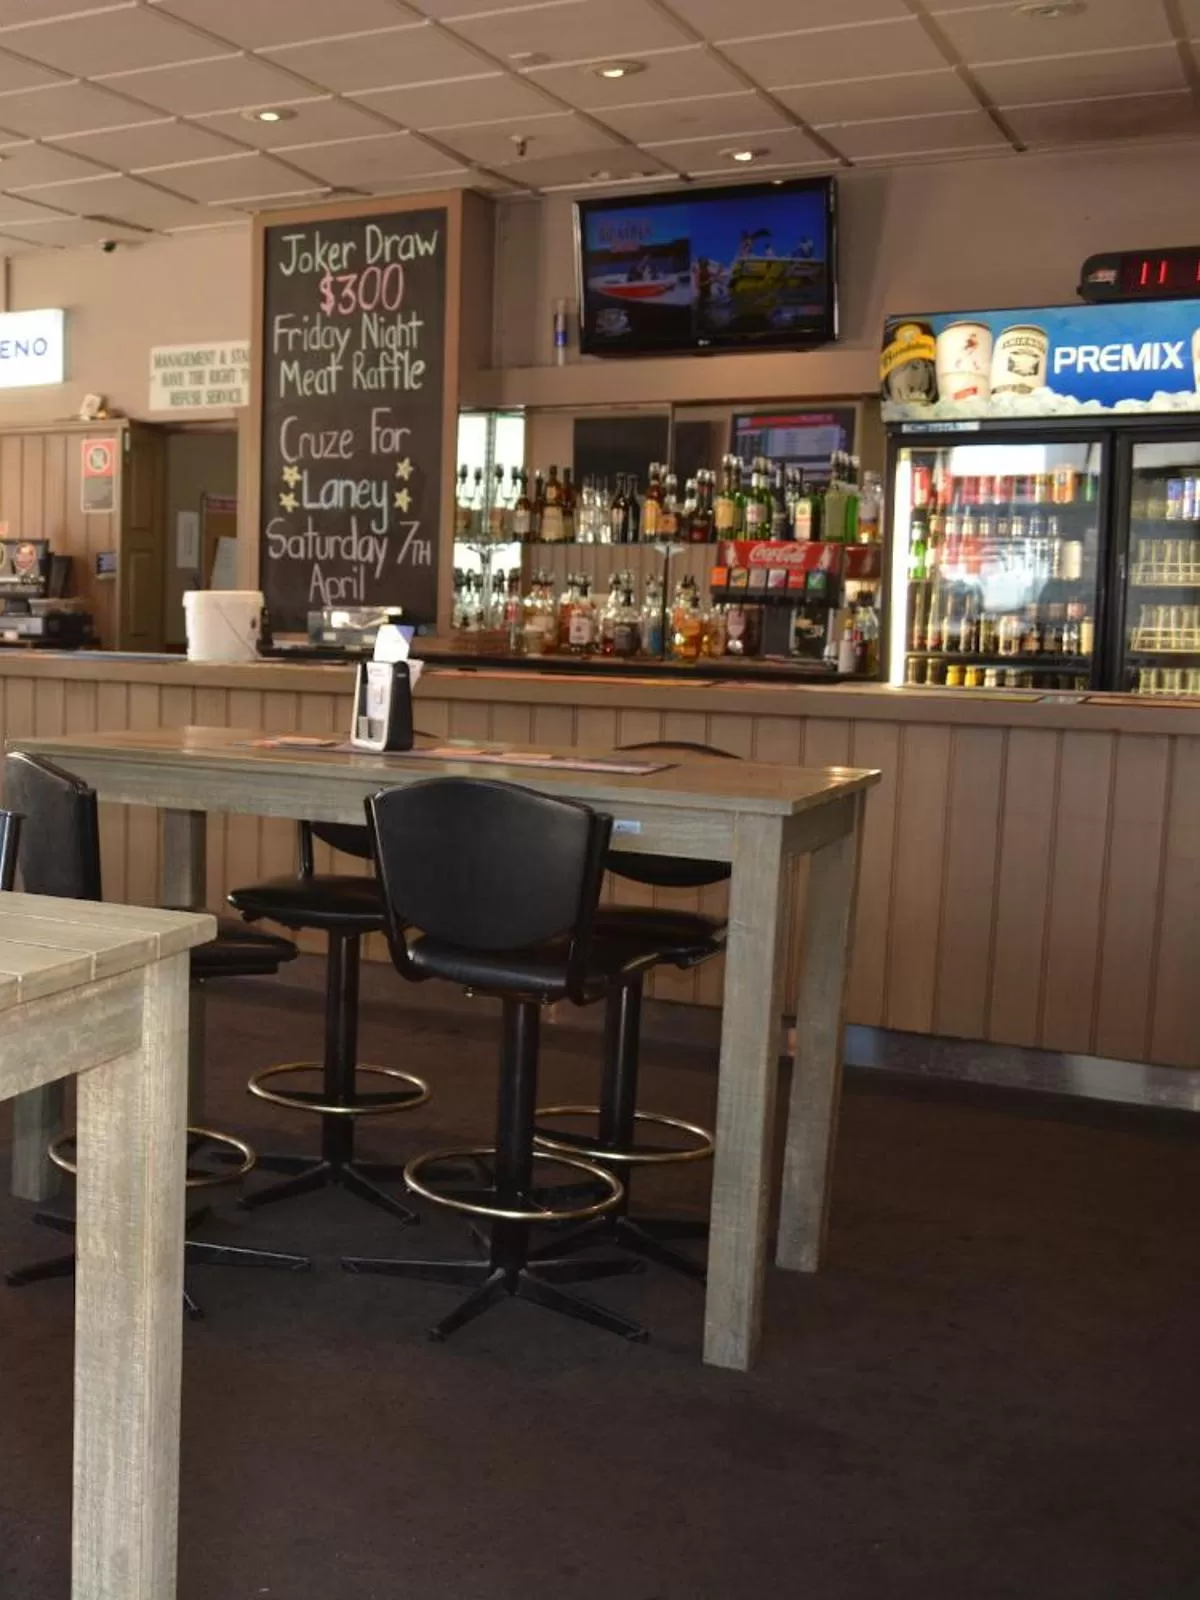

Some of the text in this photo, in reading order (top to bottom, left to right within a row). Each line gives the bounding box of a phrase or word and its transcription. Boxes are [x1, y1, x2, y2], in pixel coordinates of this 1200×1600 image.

[279, 223, 439, 276] Joker Draw
[318, 263, 405, 317] $300
[273, 311, 425, 364] Friday Night
[1053, 340, 1185, 375] PREMIX
[279, 349, 427, 399] Meat Raffle
[279, 407, 412, 463] Cruze For
[302, 468, 389, 535] Laney
[265, 515, 389, 580] Saturday
[308, 563, 366, 608] April
